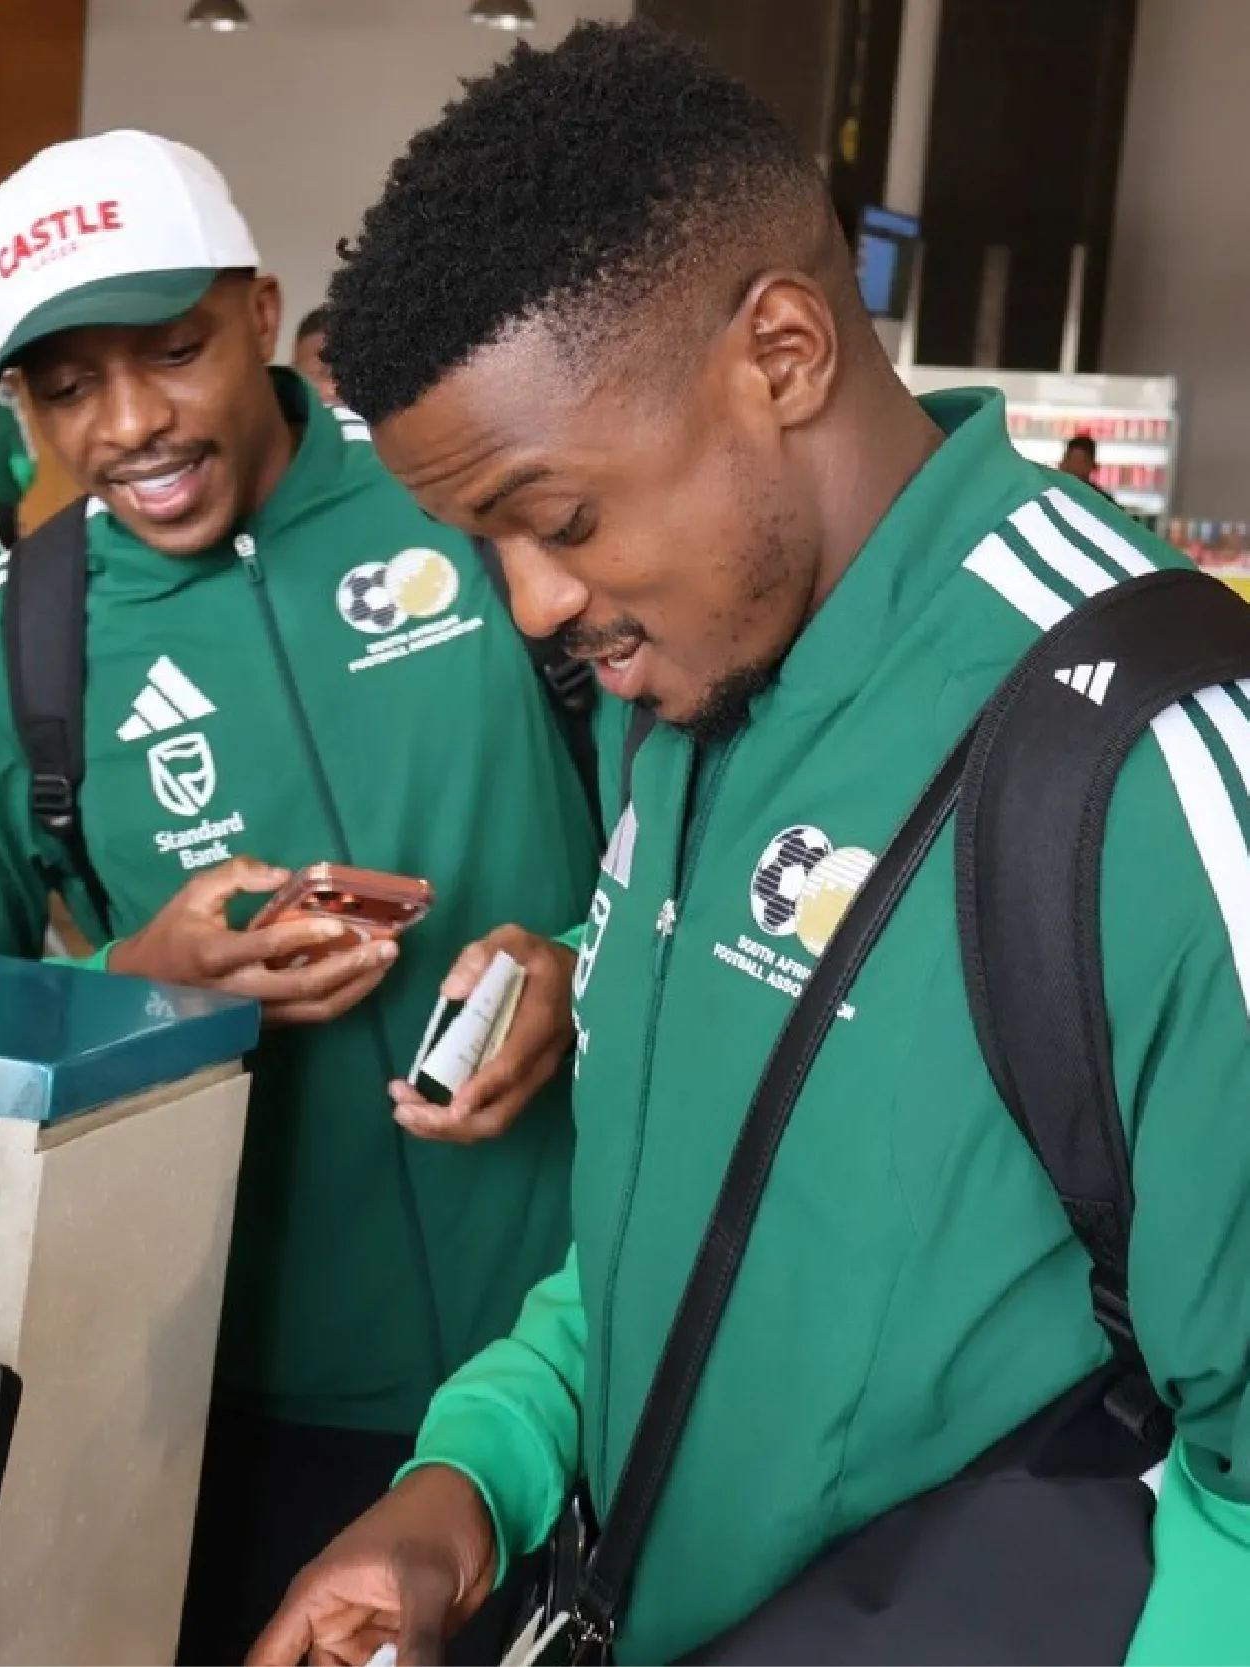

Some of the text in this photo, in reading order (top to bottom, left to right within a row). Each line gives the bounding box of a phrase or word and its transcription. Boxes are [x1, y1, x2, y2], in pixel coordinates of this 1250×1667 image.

[153, 812, 245, 853] Standard
[180, 839, 232, 870] Bank
[713, 942, 764, 980] FOOTBALL
[737, 934, 776, 965] SOUTH
